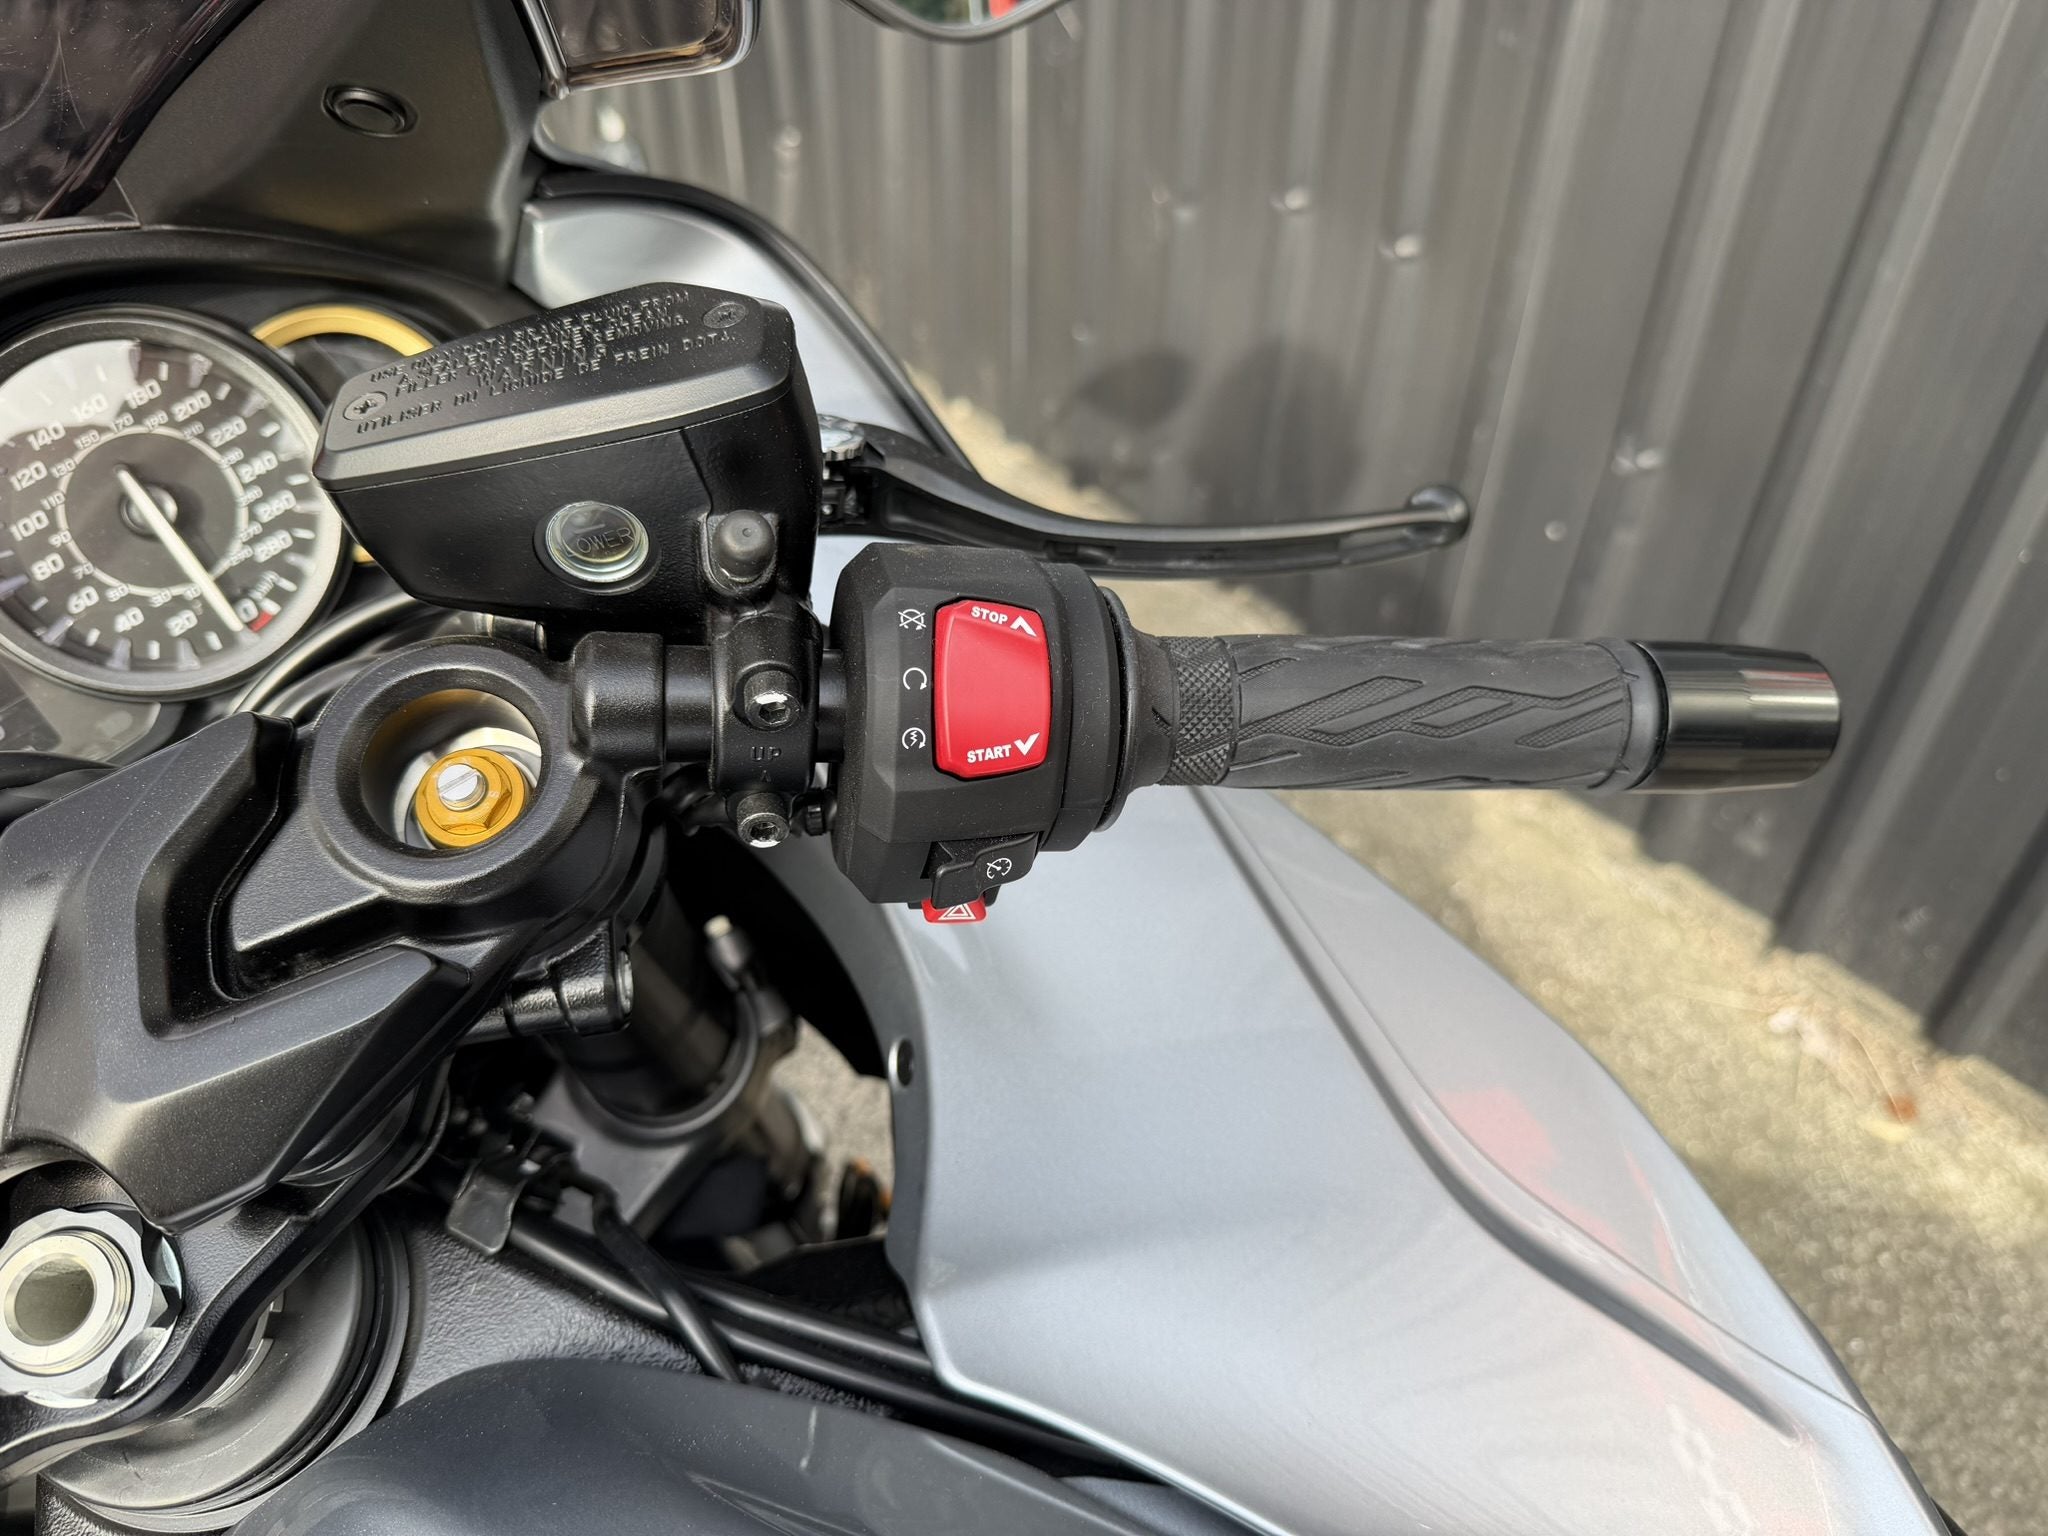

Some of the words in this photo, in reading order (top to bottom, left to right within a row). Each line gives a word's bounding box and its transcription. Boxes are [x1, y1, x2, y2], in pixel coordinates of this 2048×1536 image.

[581, 305, 632, 324] FLUID
[640, 289, 689, 308] FROM
[478, 344, 607, 388] WARNING
[126, 380, 162, 409] 180
[356, 400, 442, 434] UTILISER
[454, 391, 478, 408] DU
[489, 367, 565, 397] LIQUIDE
[578, 359, 602, 376] DE
[613, 343, 670, 366] FREIN
[71, 392, 108, 421] 160
[172, 390, 212, 421] 200
[28, 422, 66, 451] 140
[111, 412, 134, 434] 170
[208, 416, 247, 447] 220
[75, 430, 100, 450] 150
[10, 461, 47, 492] 120
[51, 458, 77, 478] 130
[238, 451, 278, 483] 240
[41, 490, 65, 510] 110
[255, 490, 296, 521] 260
[9, 512, 48, 541] 100
[49, 531, 72, 549] 90
[255, 530, 293, 562] 280
[31, 552, 64, 581] 80
[73, 562, 94, 579] 70
[68, 586, 99, 614] 60
[236, 597, 259, 624] 0
[113, 606, 145, 632] 40
[166, 608, 199, 637] 20
[971, 606, 1008, 625] STOP
[751, 746, 782, 762] UP
[967, 743, 1012, 764] START
